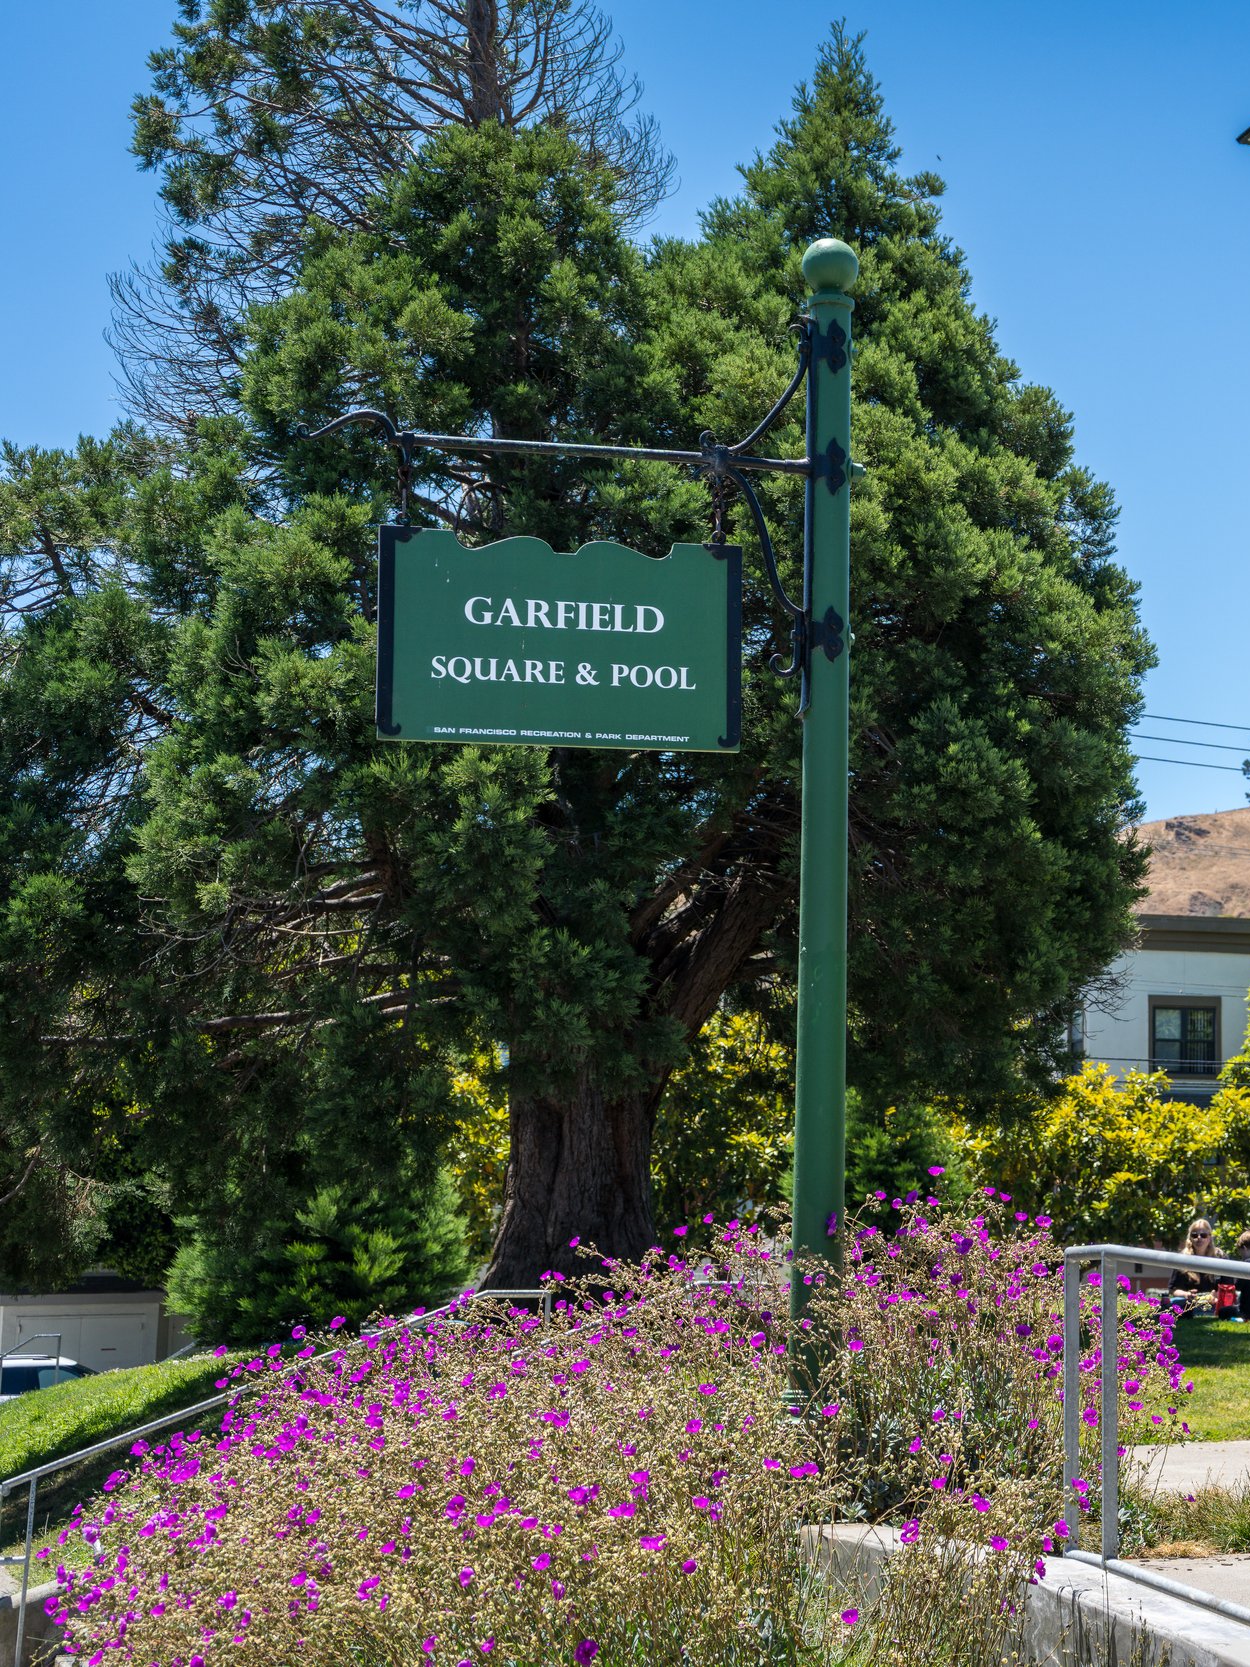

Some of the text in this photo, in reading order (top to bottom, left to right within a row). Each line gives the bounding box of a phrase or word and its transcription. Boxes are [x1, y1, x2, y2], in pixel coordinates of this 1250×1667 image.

[464, 596, 665, 634] GARFIELD
[430, 655, 697, 690] SQUARE & POOL
[433, 726, 456, 734] SAN
[458, 727, 517, 736] FRANCISCO
[520, 729, 582, 739] RECREATION
[595, 732, 622, 740] PARK
[625, 733, 690, 743] DEPARTMENT
